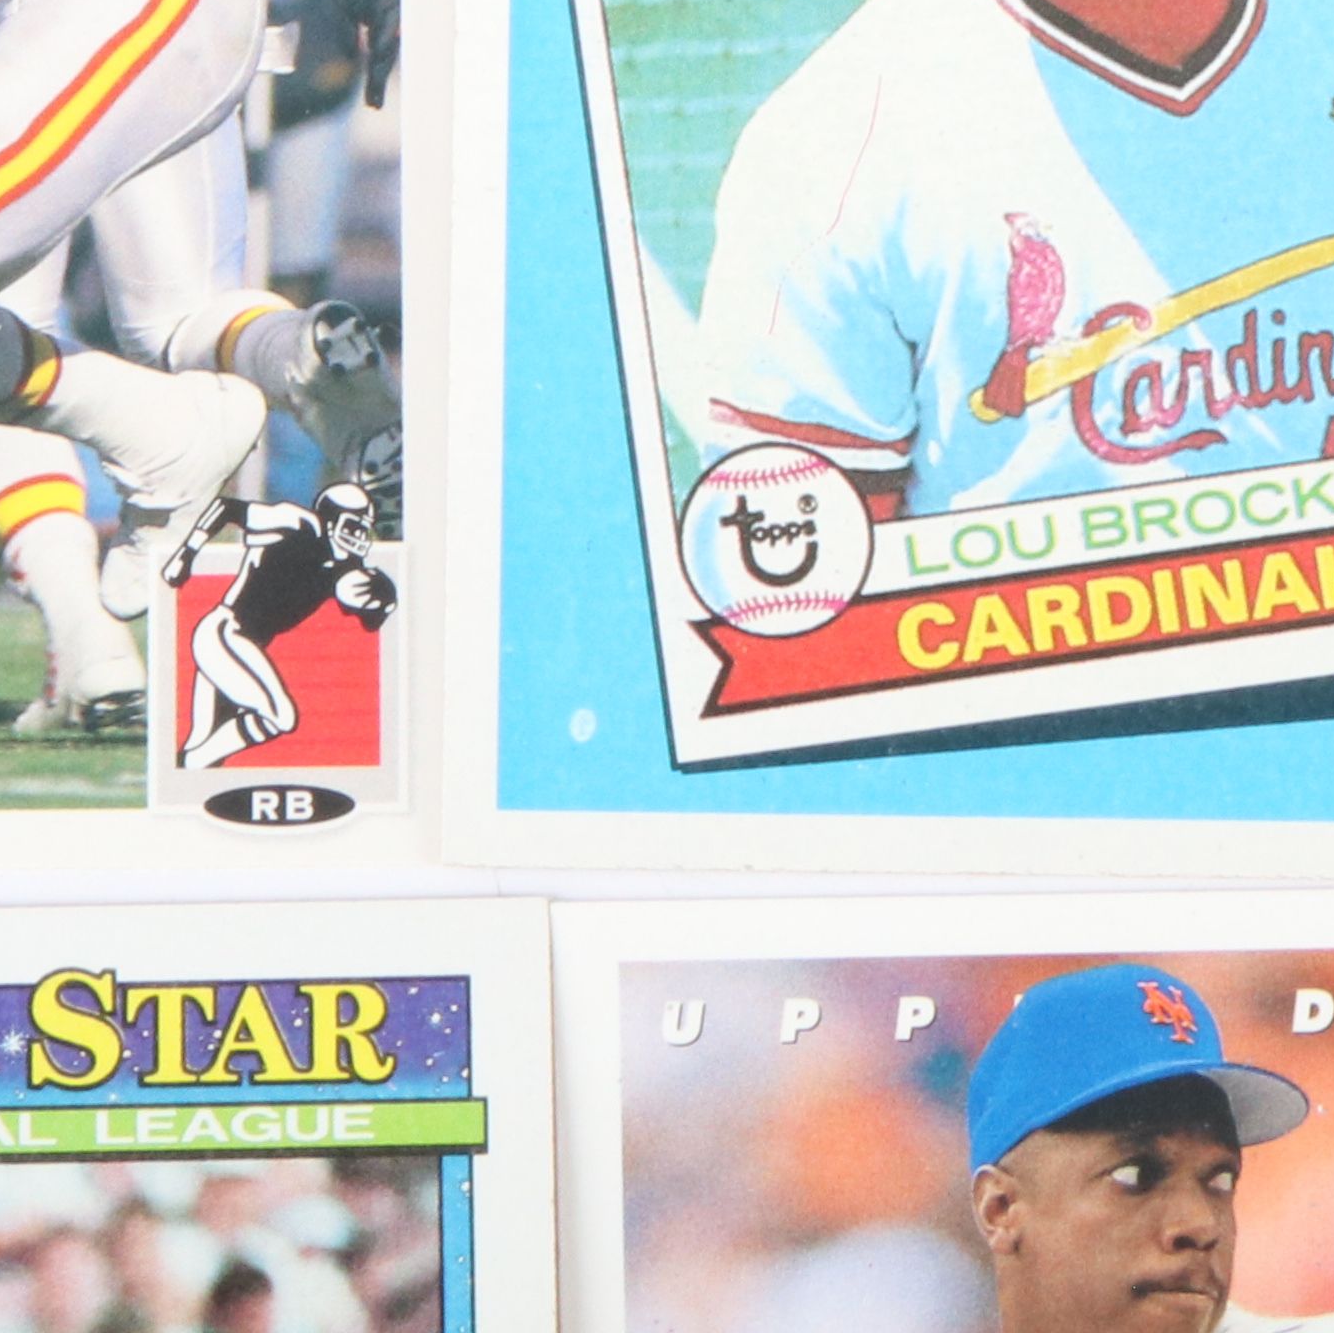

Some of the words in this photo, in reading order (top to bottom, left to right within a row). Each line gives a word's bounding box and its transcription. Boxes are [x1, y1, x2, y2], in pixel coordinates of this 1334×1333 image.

[903, 512, 1059, 578] LOU
[250, 789, 315, 822] RB
[27, 966, 398, 1091] STAR
[660, 993, 1025, 1047] UPP
[94, 1104, 377, 1147] LEAGUE
